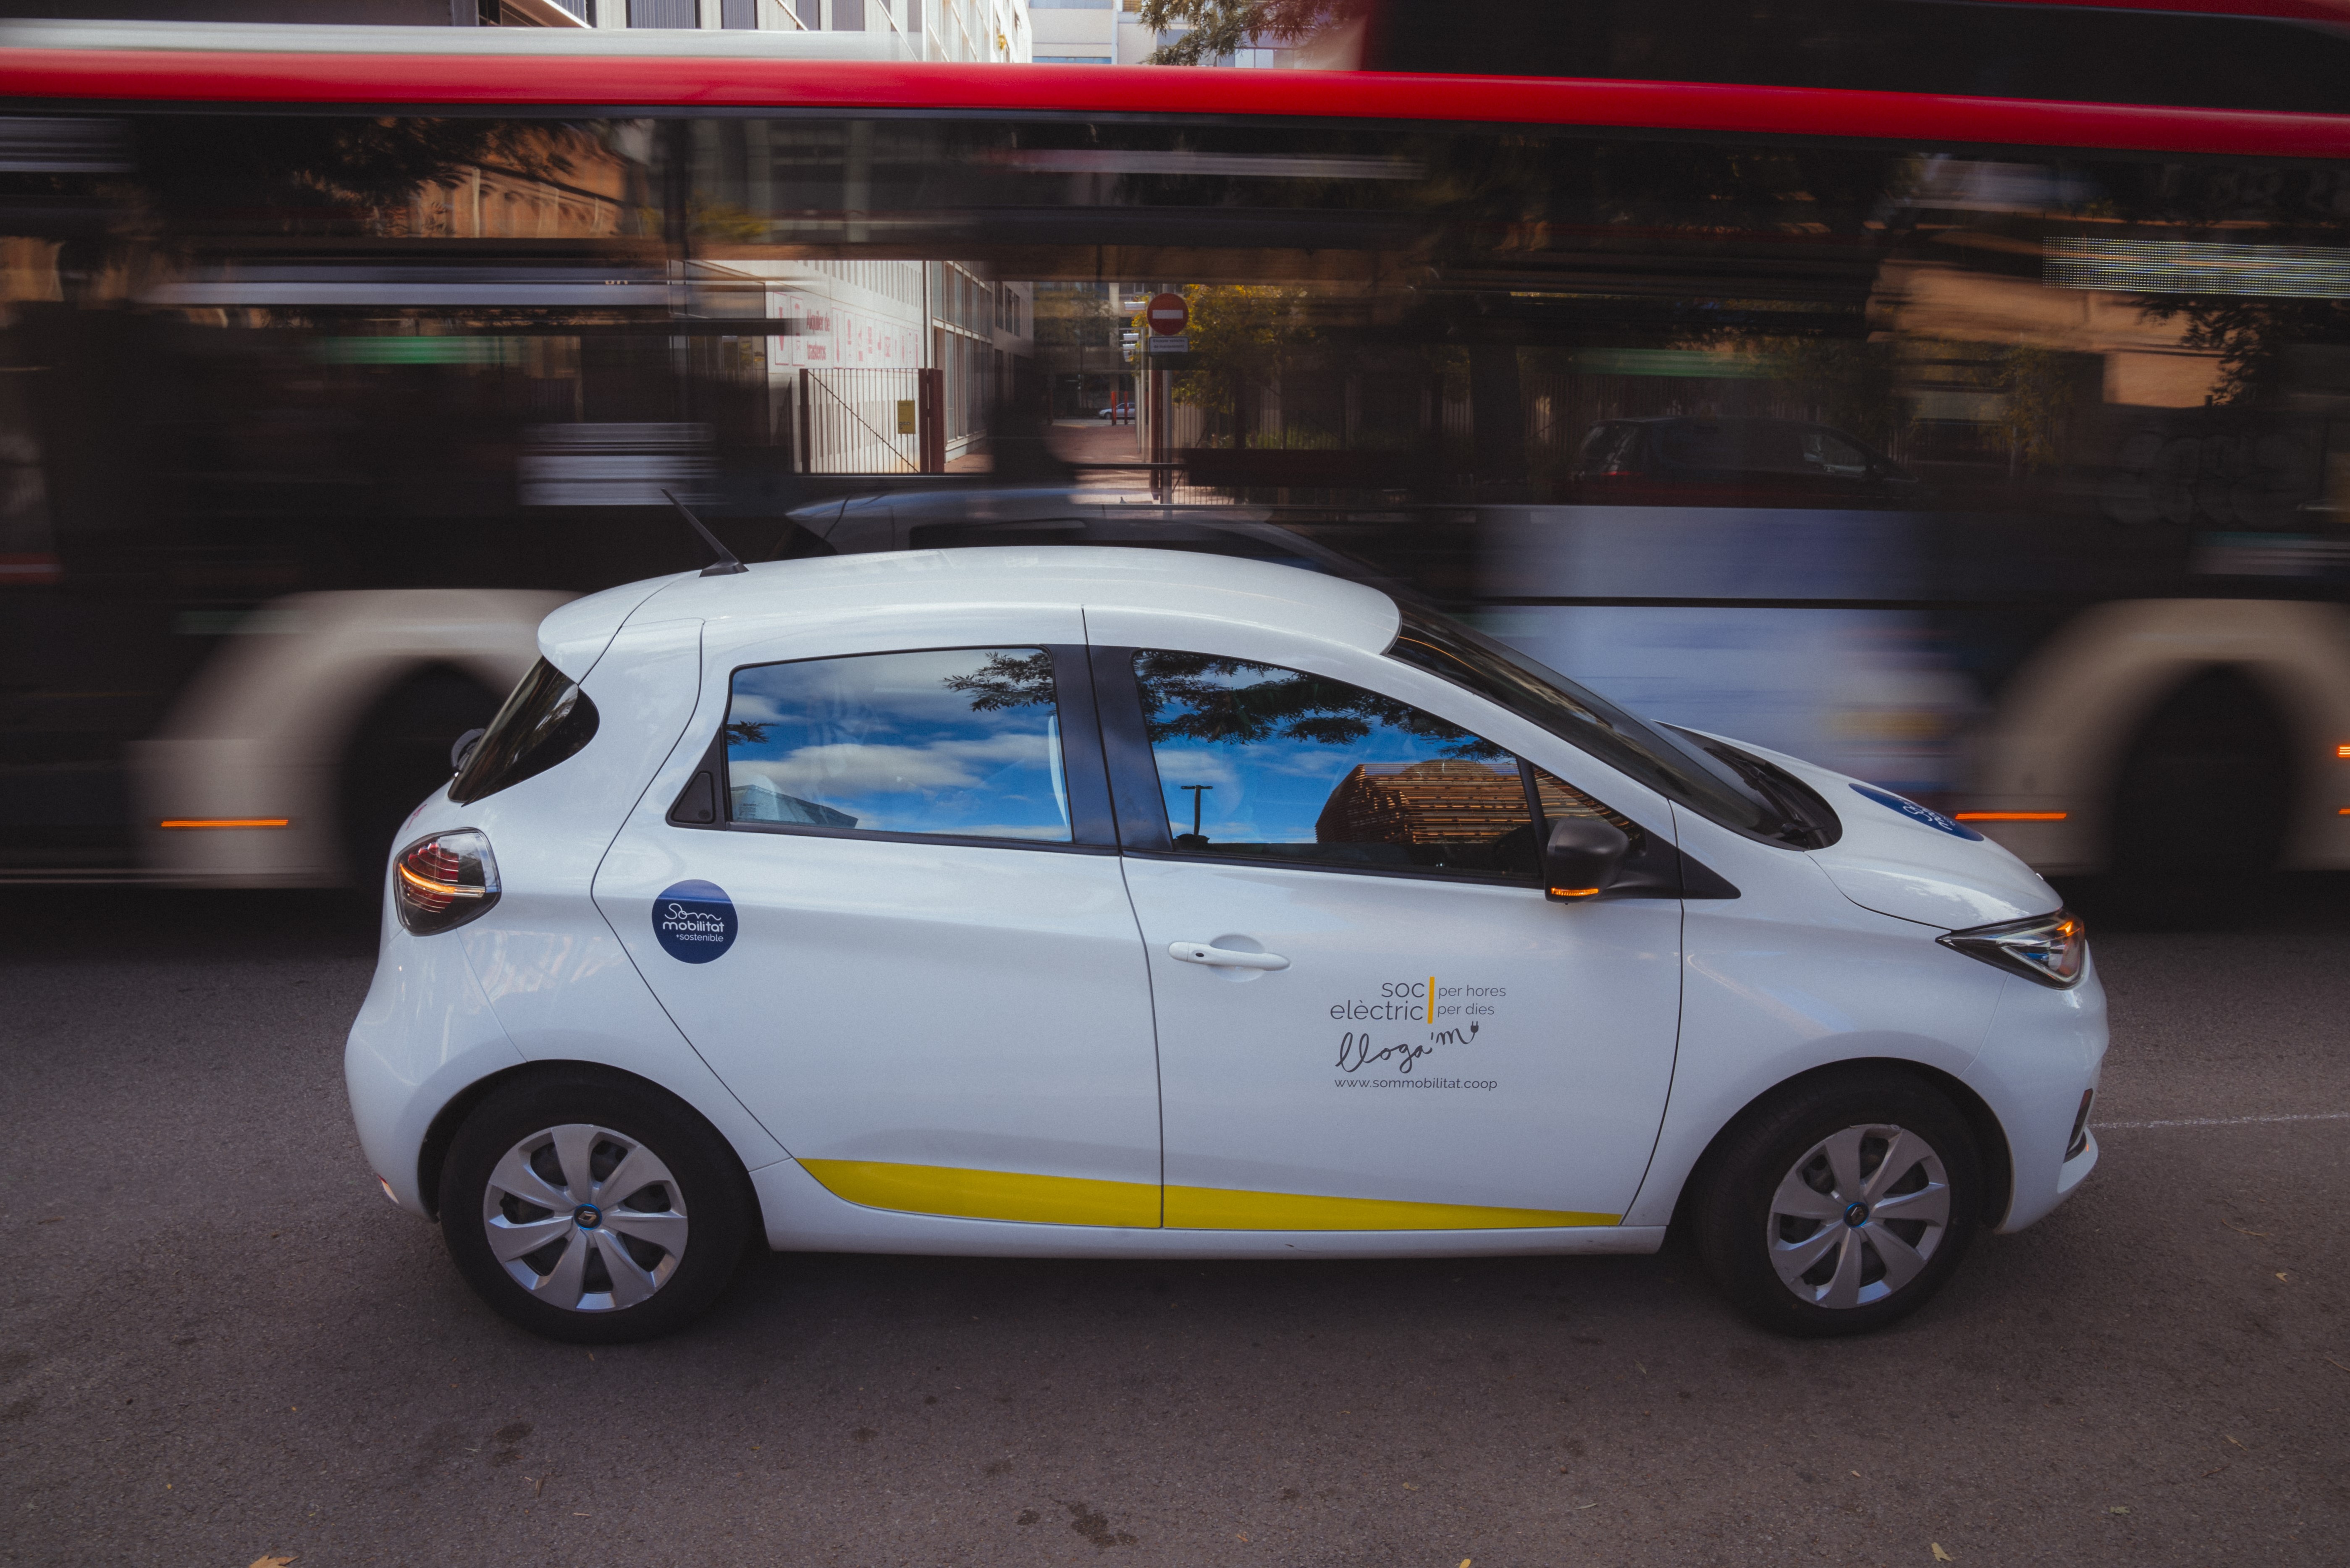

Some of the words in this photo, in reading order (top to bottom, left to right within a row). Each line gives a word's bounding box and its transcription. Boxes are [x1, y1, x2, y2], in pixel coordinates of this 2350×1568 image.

[824, 312, 830, 332] de
[664, 903, 722, 921] Som
[662, 920, 725, 932] mobilitat
[676, 933, 724, 942] +sostenible
[1438, 987, 1463, 999] per
[1466, 984, 1506, 997] hores
[1330, 1000, 1423, 1020] elèctric
[1437, 1005, 1462, 1018] per
[1465, 1003, 1495, 1015] dies
[1334, 1077, 1498, 1091] www.sommobilitat.coop
